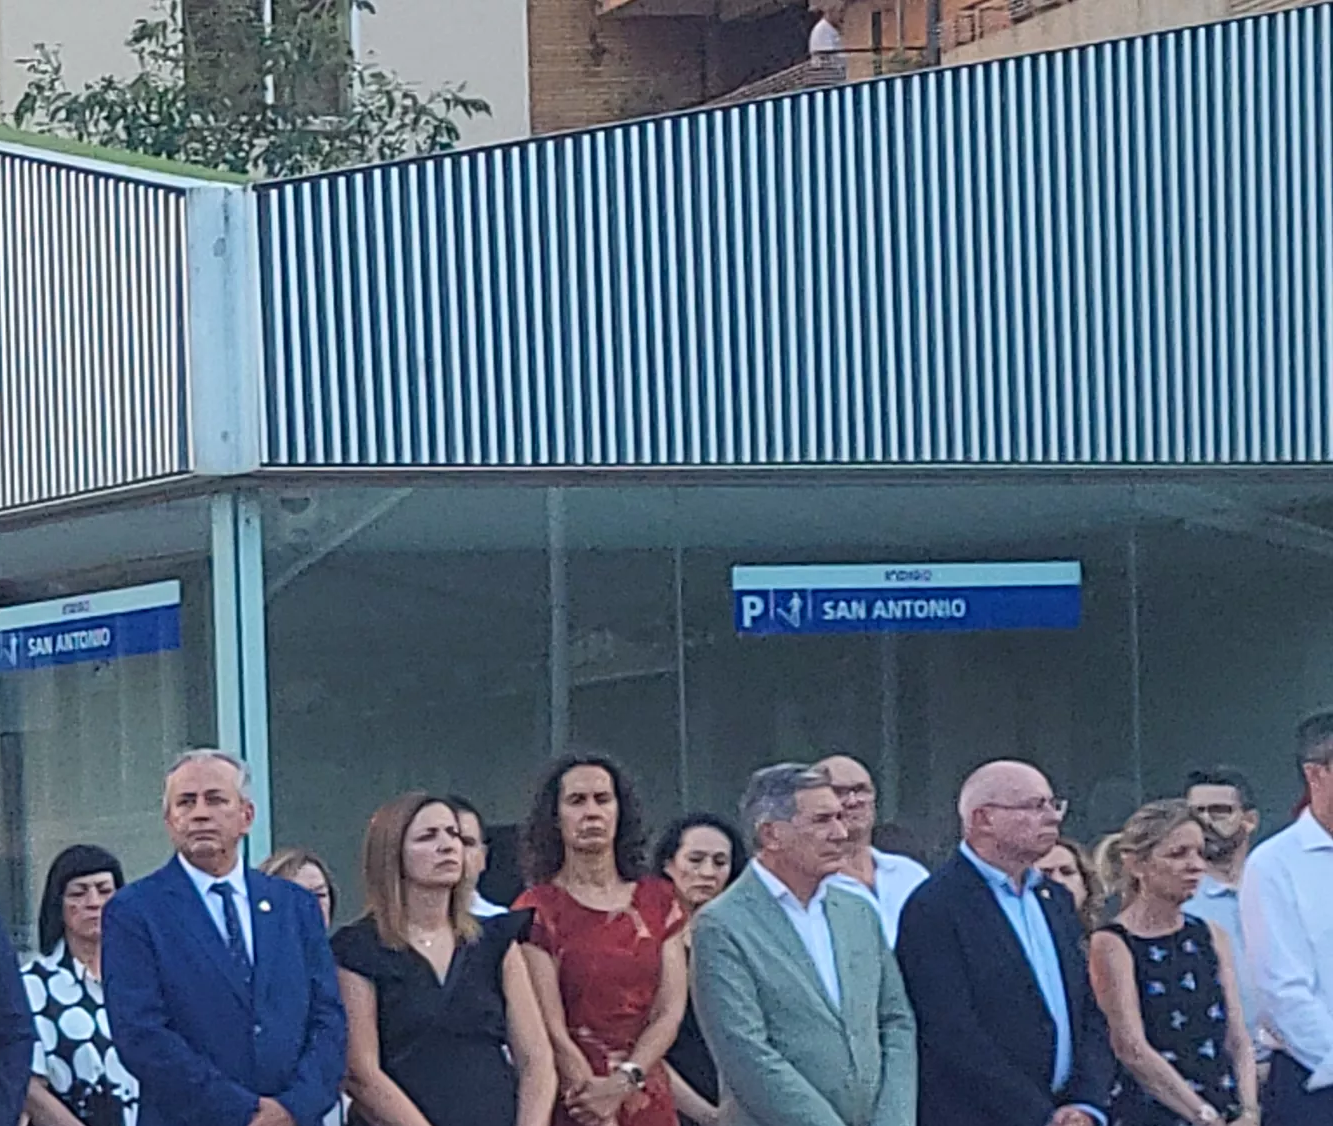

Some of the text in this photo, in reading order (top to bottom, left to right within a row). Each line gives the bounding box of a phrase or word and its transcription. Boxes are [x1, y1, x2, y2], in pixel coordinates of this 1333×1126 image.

[741, 595, 967, 628] P SAN ANTONIO
[27, 635, 53, 658] SAN
[55, 627, 111, 654] ANTONIO
